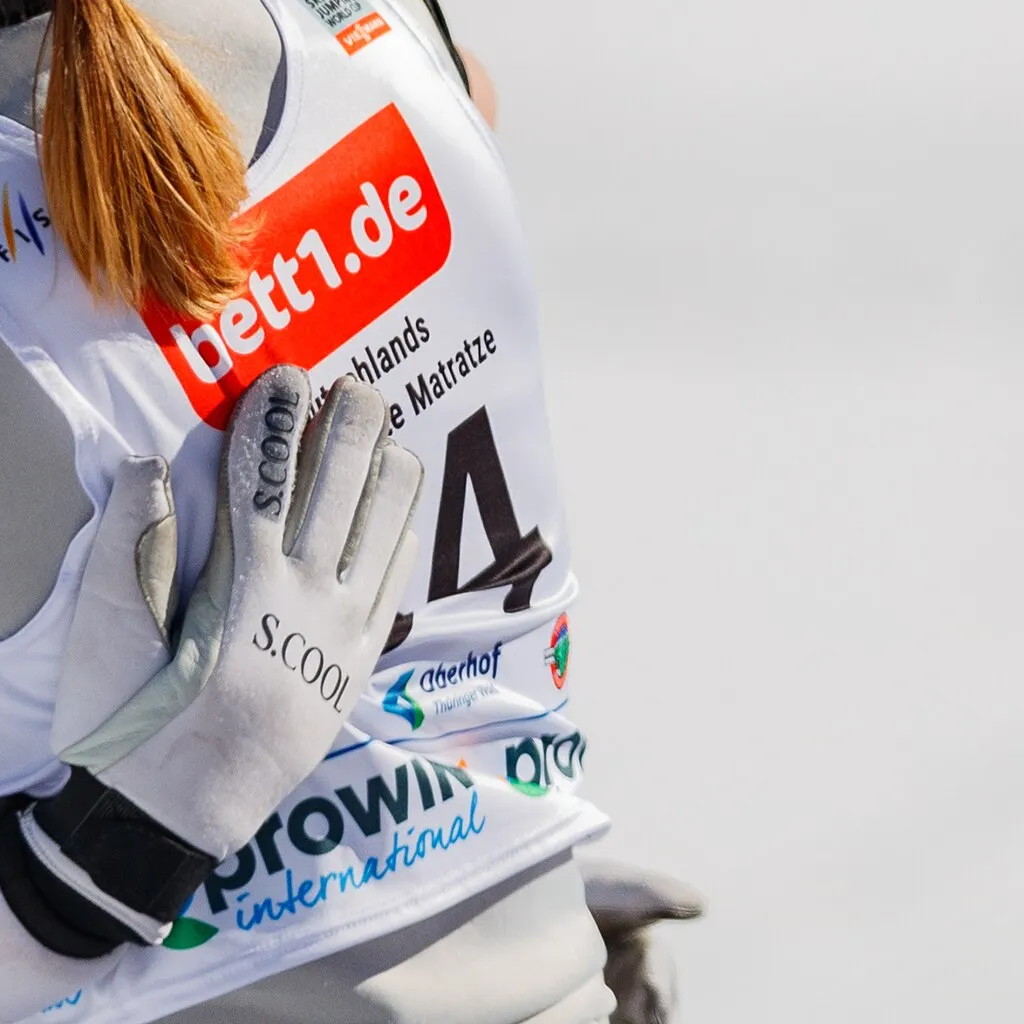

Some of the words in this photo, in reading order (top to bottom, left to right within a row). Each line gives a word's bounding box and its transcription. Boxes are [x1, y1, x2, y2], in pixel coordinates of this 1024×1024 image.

[169, 175, 427, 384] bett1.de
[405, 329, 497, 416] Matratze
[253, 388, 301, 516] S.COOL
[252, 613, 351, 713] S.COOL
[235, 789, 485, 931] international
